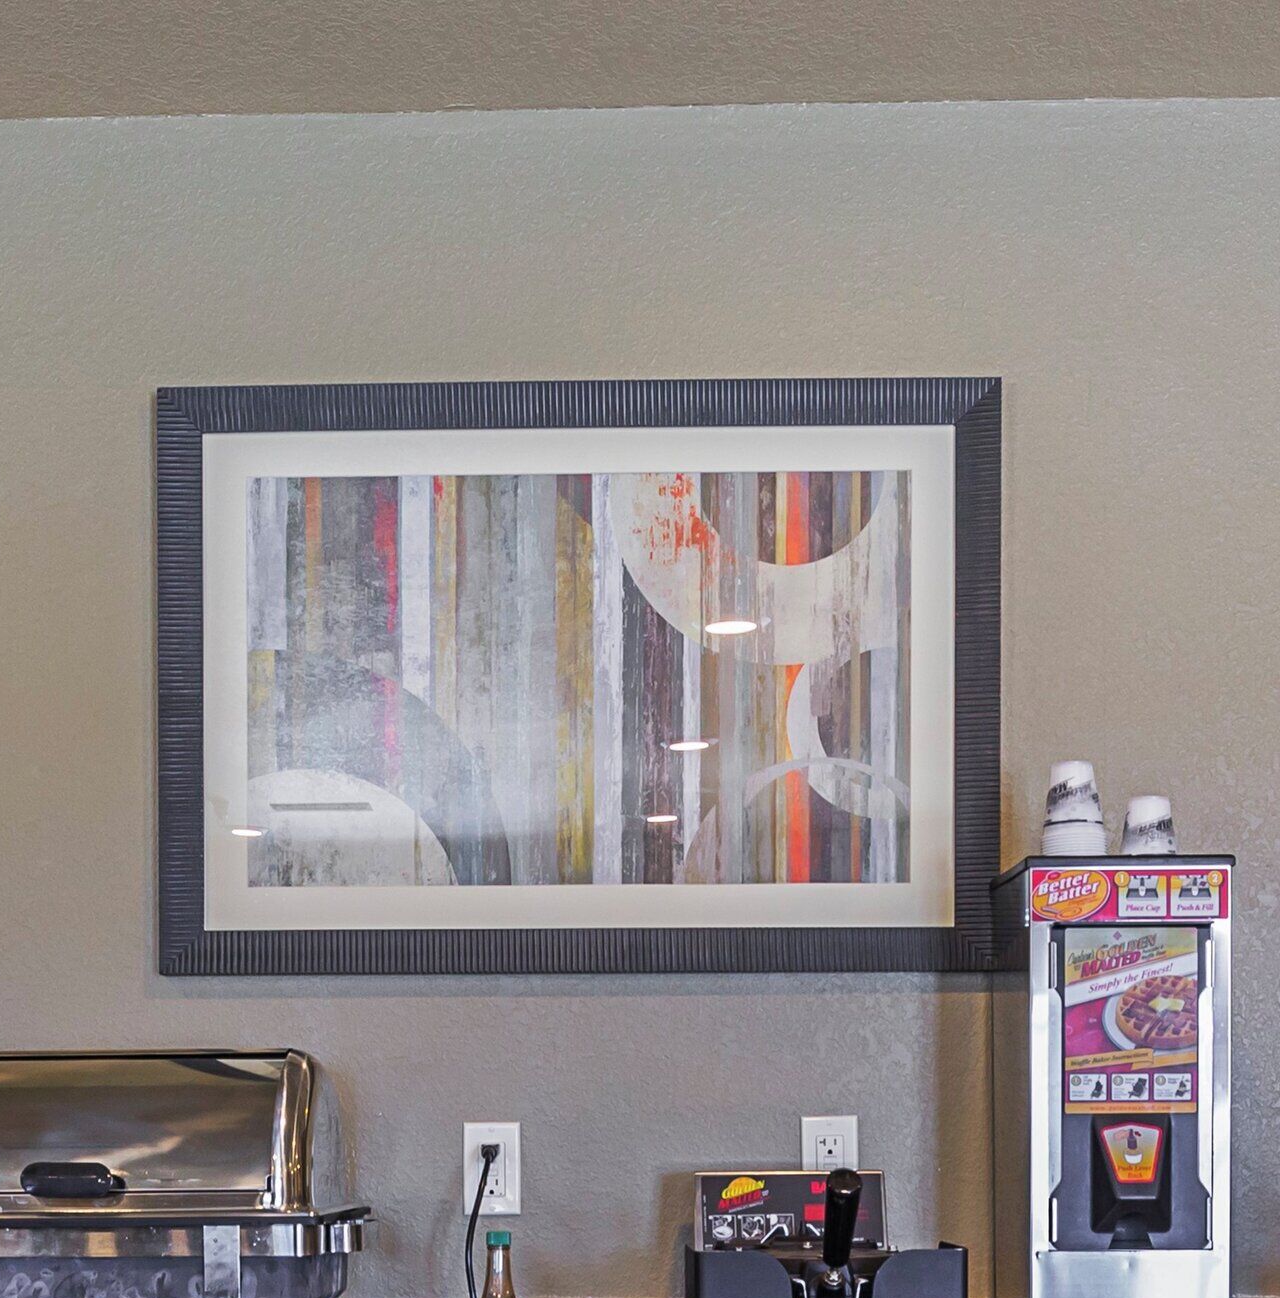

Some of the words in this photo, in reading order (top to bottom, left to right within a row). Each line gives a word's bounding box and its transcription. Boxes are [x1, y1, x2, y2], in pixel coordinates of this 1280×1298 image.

[1038, 872, 1090, 896] Better
[1047, 881, 1099, 905] Batter
[1081, 951, 1141, 978] MALTED
[1088, 977, 1121, 993] Simply
[1124, 973, 1139, 984] the
[1141, 962, 1174, 980] Finest!
